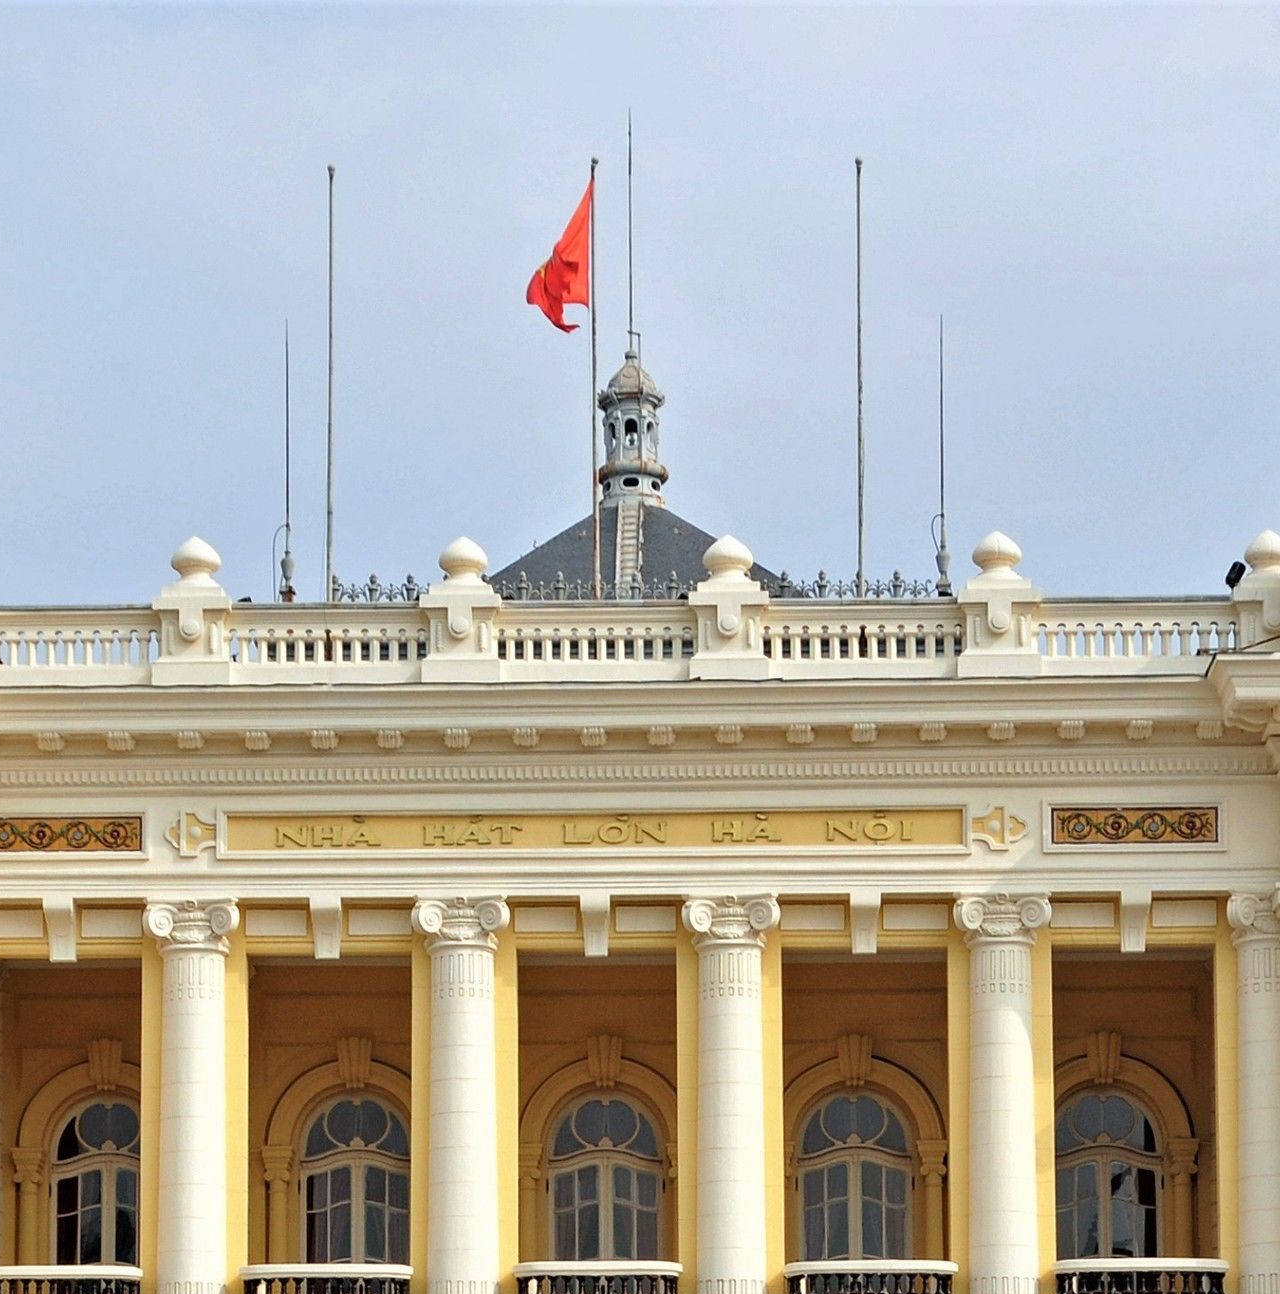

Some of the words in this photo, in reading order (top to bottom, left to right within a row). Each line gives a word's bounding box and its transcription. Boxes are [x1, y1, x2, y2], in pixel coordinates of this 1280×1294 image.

[275, 815, 381, 847] NHÀ
[423, 815, 523, 847] HÁT
[712, 812, 782, 842] HÀ
[826, 811, 913, 846] NỘI
